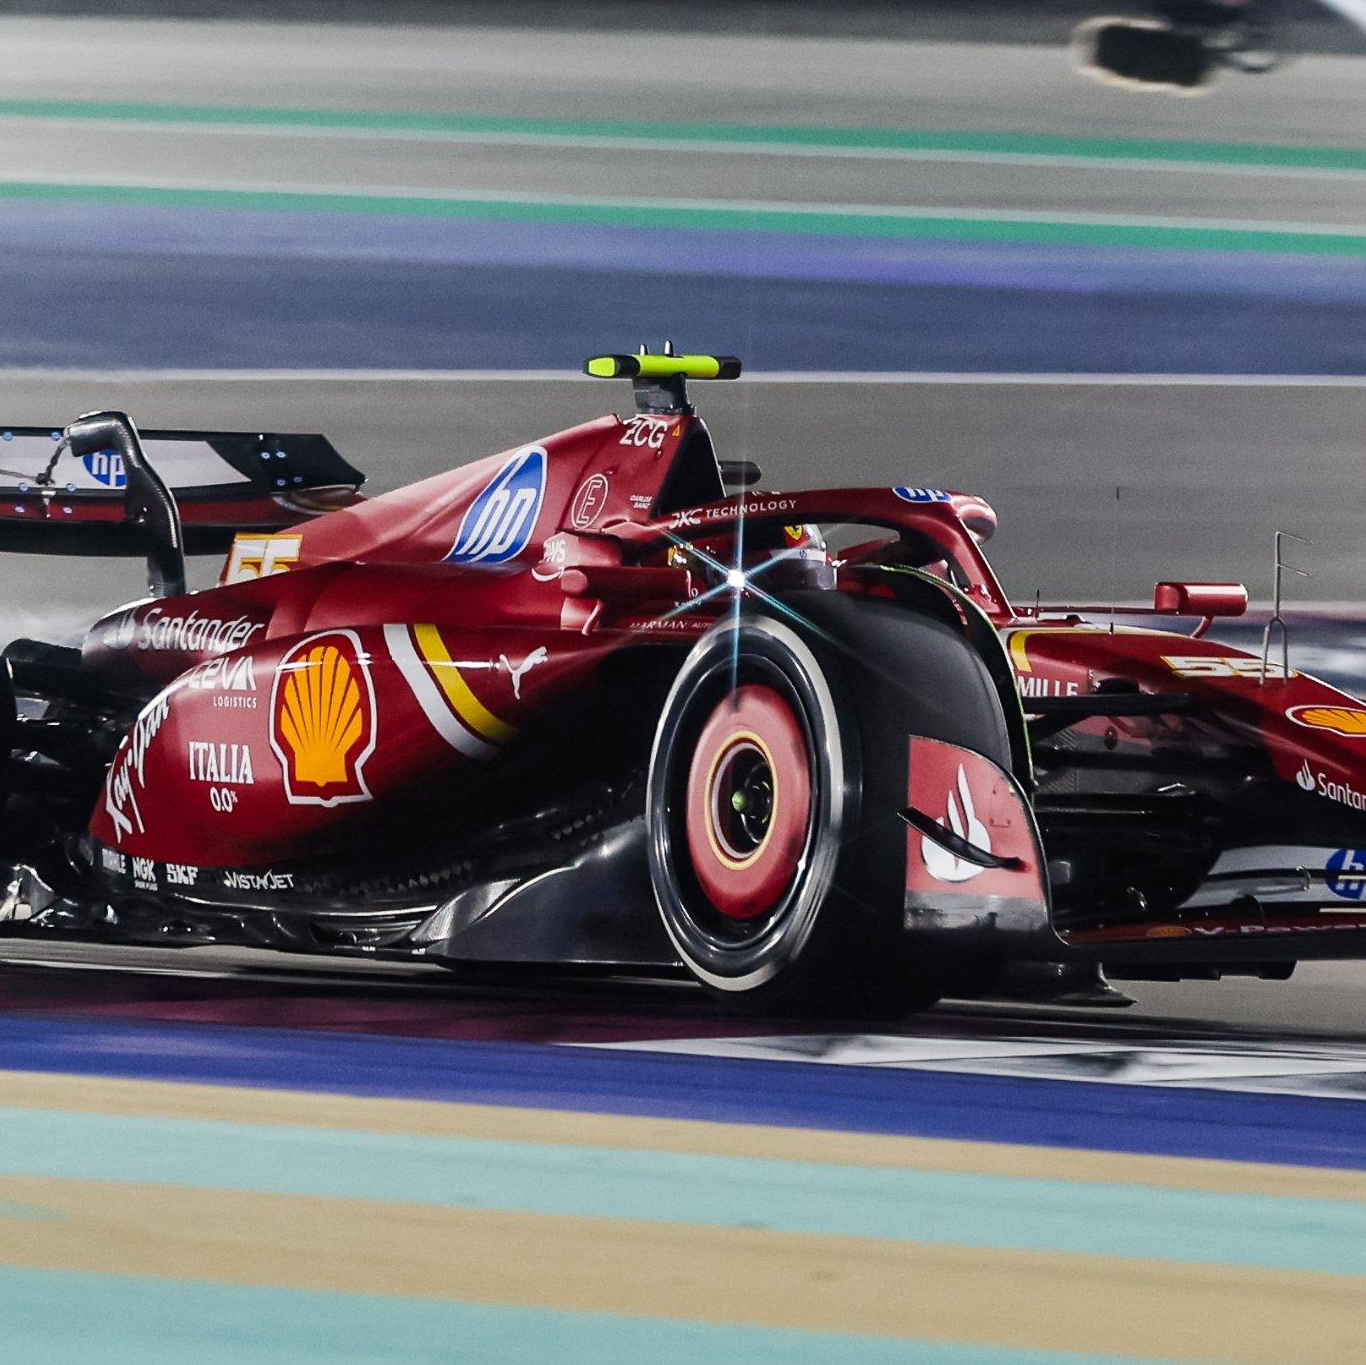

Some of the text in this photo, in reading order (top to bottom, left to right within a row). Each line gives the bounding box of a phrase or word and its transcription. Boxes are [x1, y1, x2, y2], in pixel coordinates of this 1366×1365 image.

[705, 499, 797, 520] TECHNOLOGY
[137, 607, 265, 653] Santander
[1160, 655, 1300, 679] 55
[213, 696, 257, 709] LOGISTICS
[189, 740, 255, 785] ITALIA
[132, 856, 157, 883] NGK
[166, 862, 199, 886] SKF
